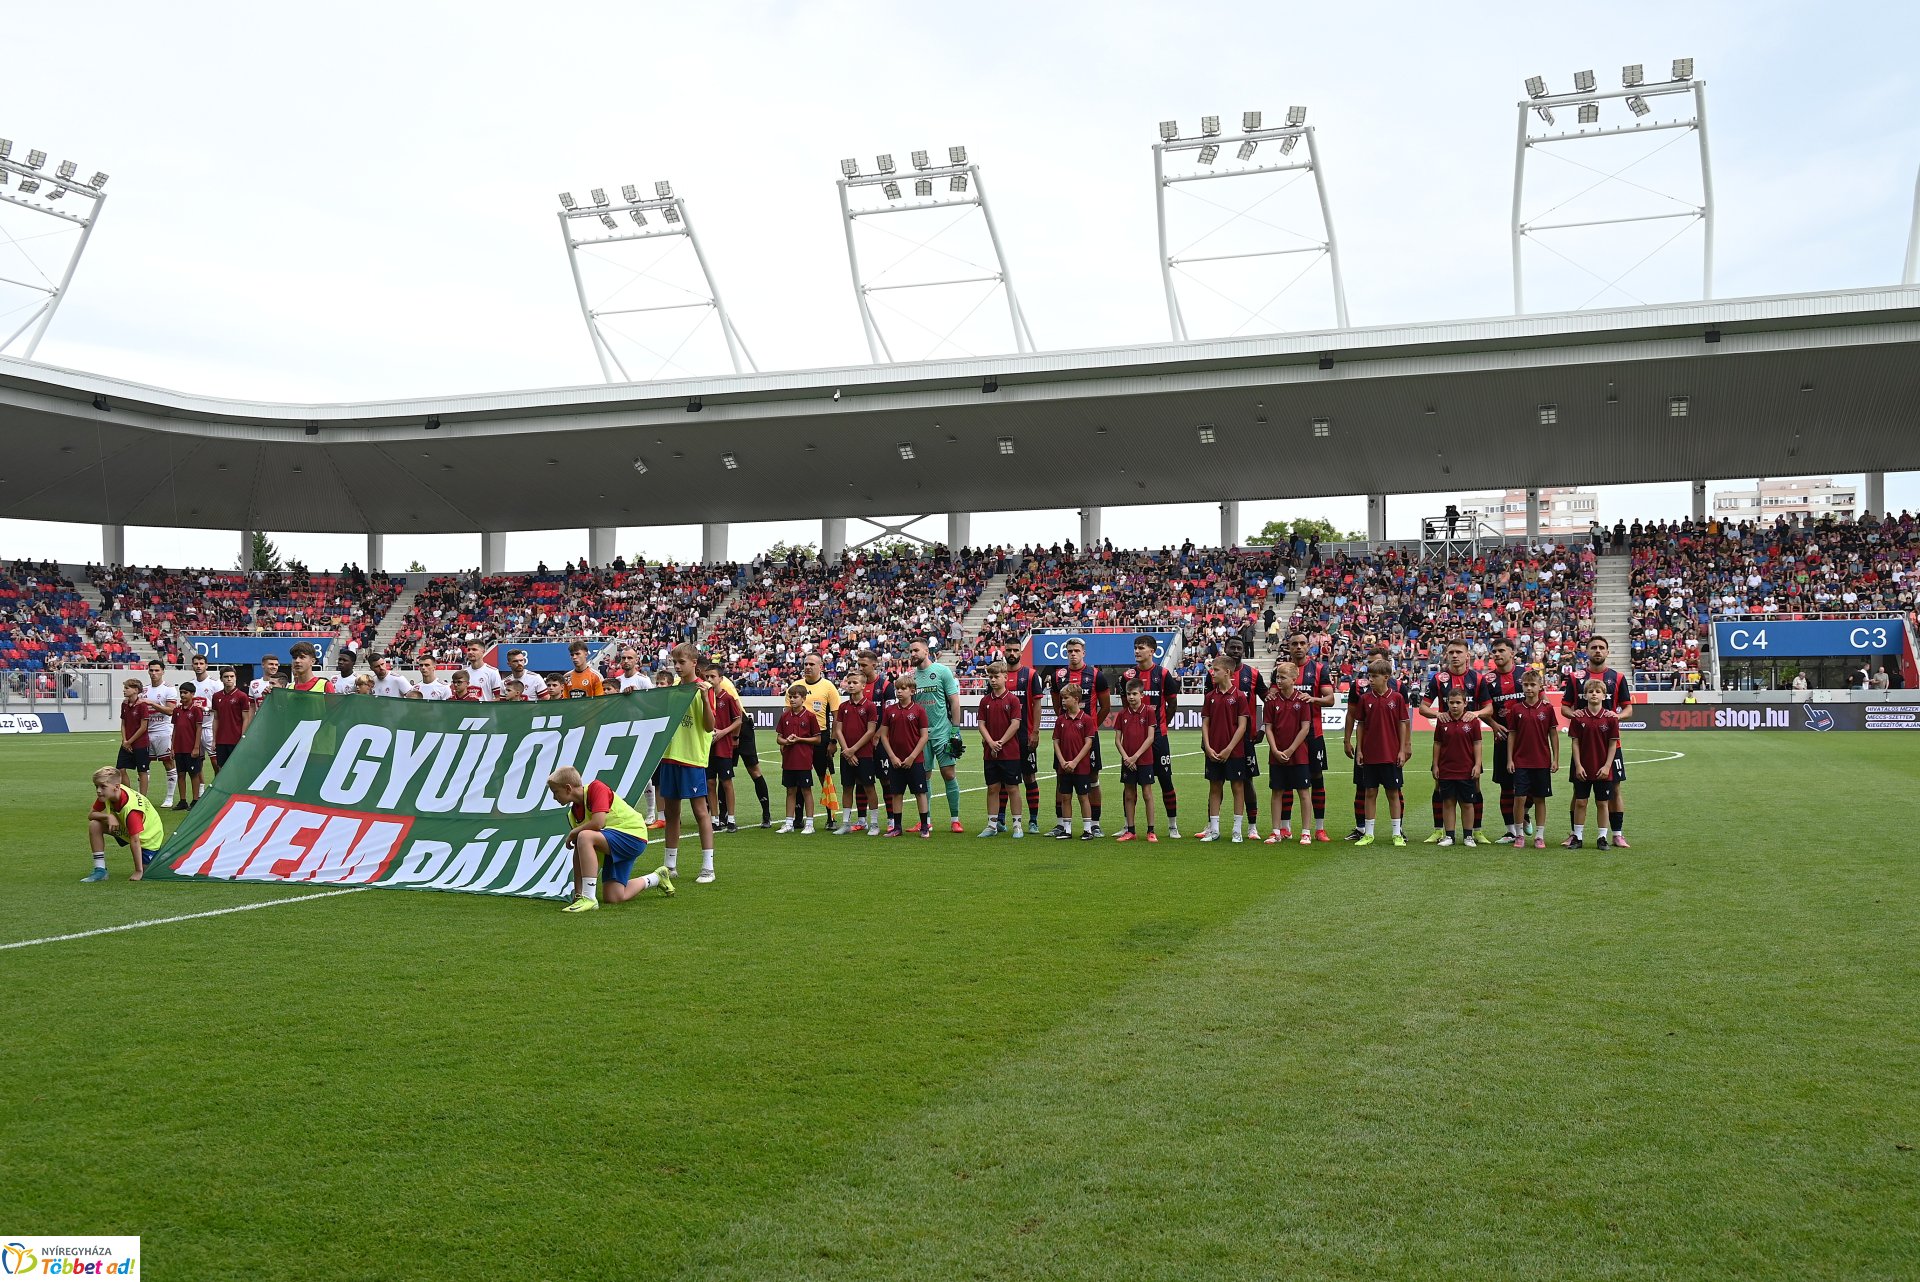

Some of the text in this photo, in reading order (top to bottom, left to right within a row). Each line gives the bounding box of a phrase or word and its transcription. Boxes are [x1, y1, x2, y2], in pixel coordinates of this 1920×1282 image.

[1152, 640, 1165, 659] 5
[1729, 629, 1769, 650] C4
[1849, 627, 1888, 649] C3
[17, 717, 39, 731] liga
[1659, 706, 1790, 731] szparishop.hu
[248, 715, 671, 814] A GYŰLÖLET
[174, 800, 405, 884] NEM
[371, 828, 575, 897] PÁLYA
